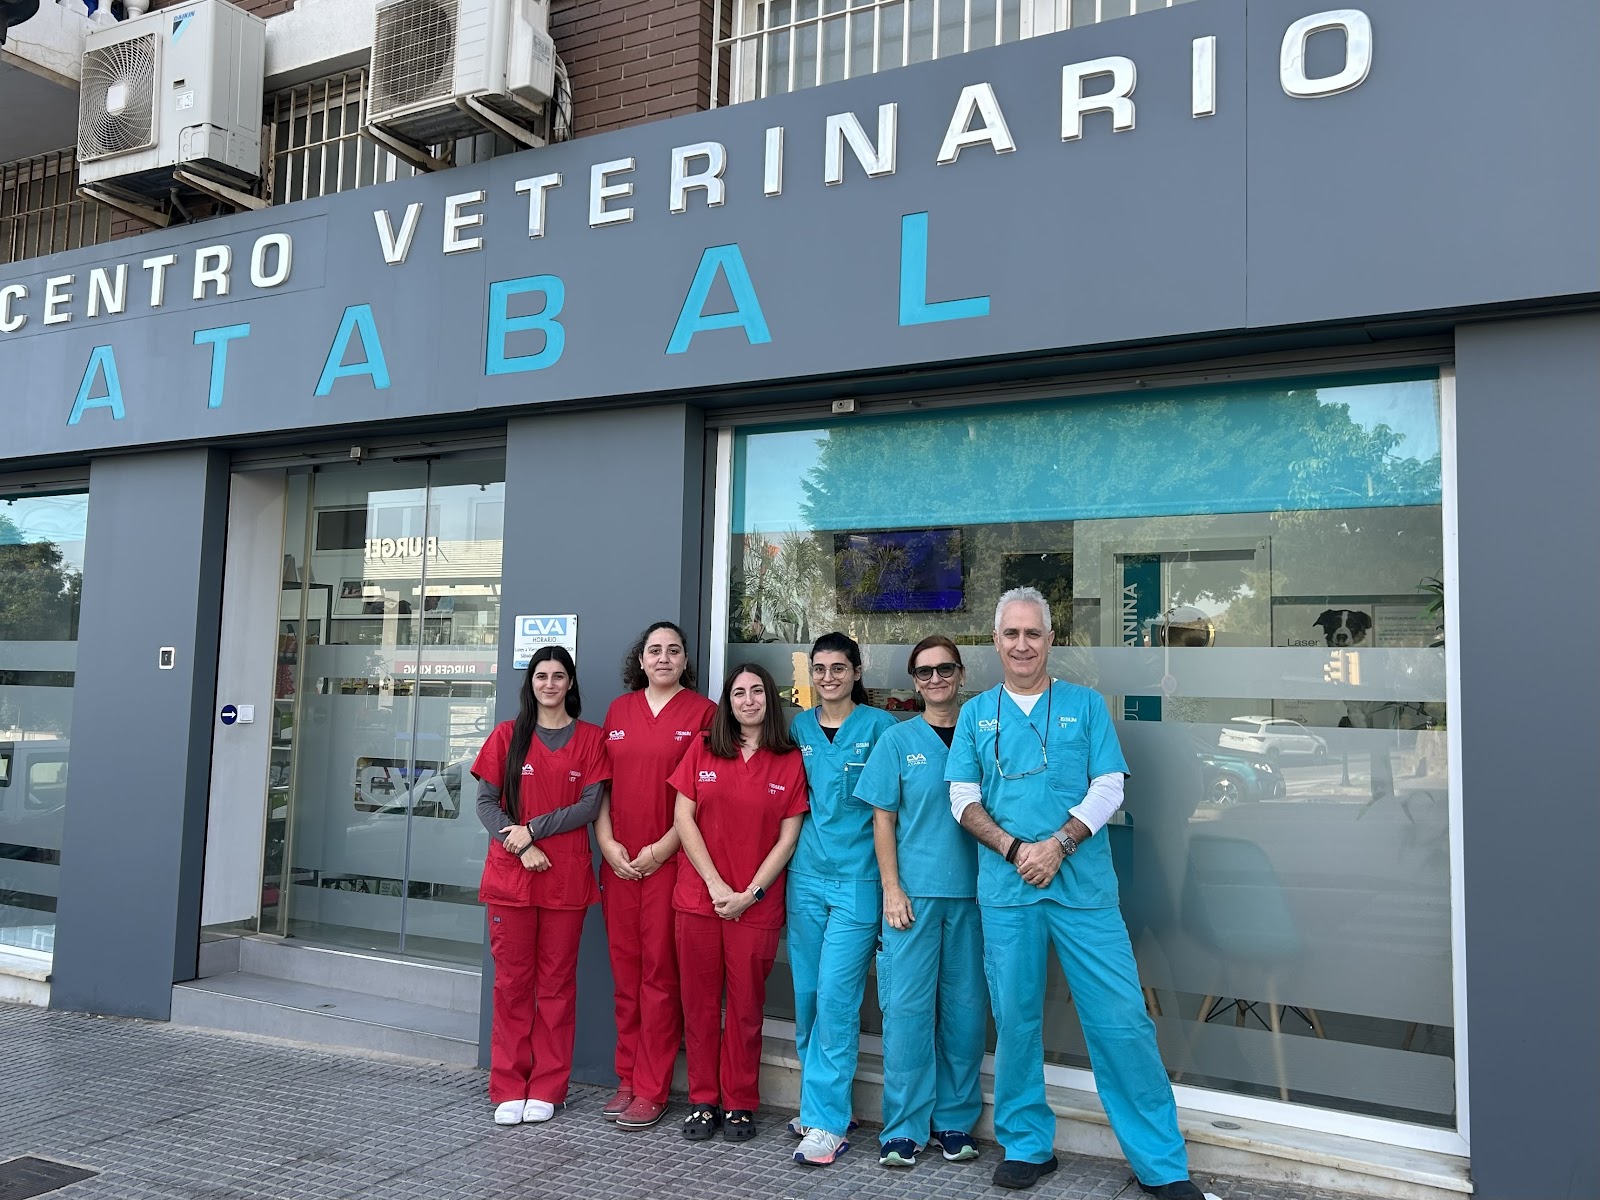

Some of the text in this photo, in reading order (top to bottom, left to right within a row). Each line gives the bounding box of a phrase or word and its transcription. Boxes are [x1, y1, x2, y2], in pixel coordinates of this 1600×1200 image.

[0, 8, 1375, 333] CENTRO VETERINARIO
[66, 211, 991, 426] ATABAL
[523, 619, 565, 635] CVA
[1287, 638, 1321, 648] Laser
[979, 719, 1001, 727] CVA
[906, 753, 927, 762] CVA
[360, 766, 456, 811] CVA
